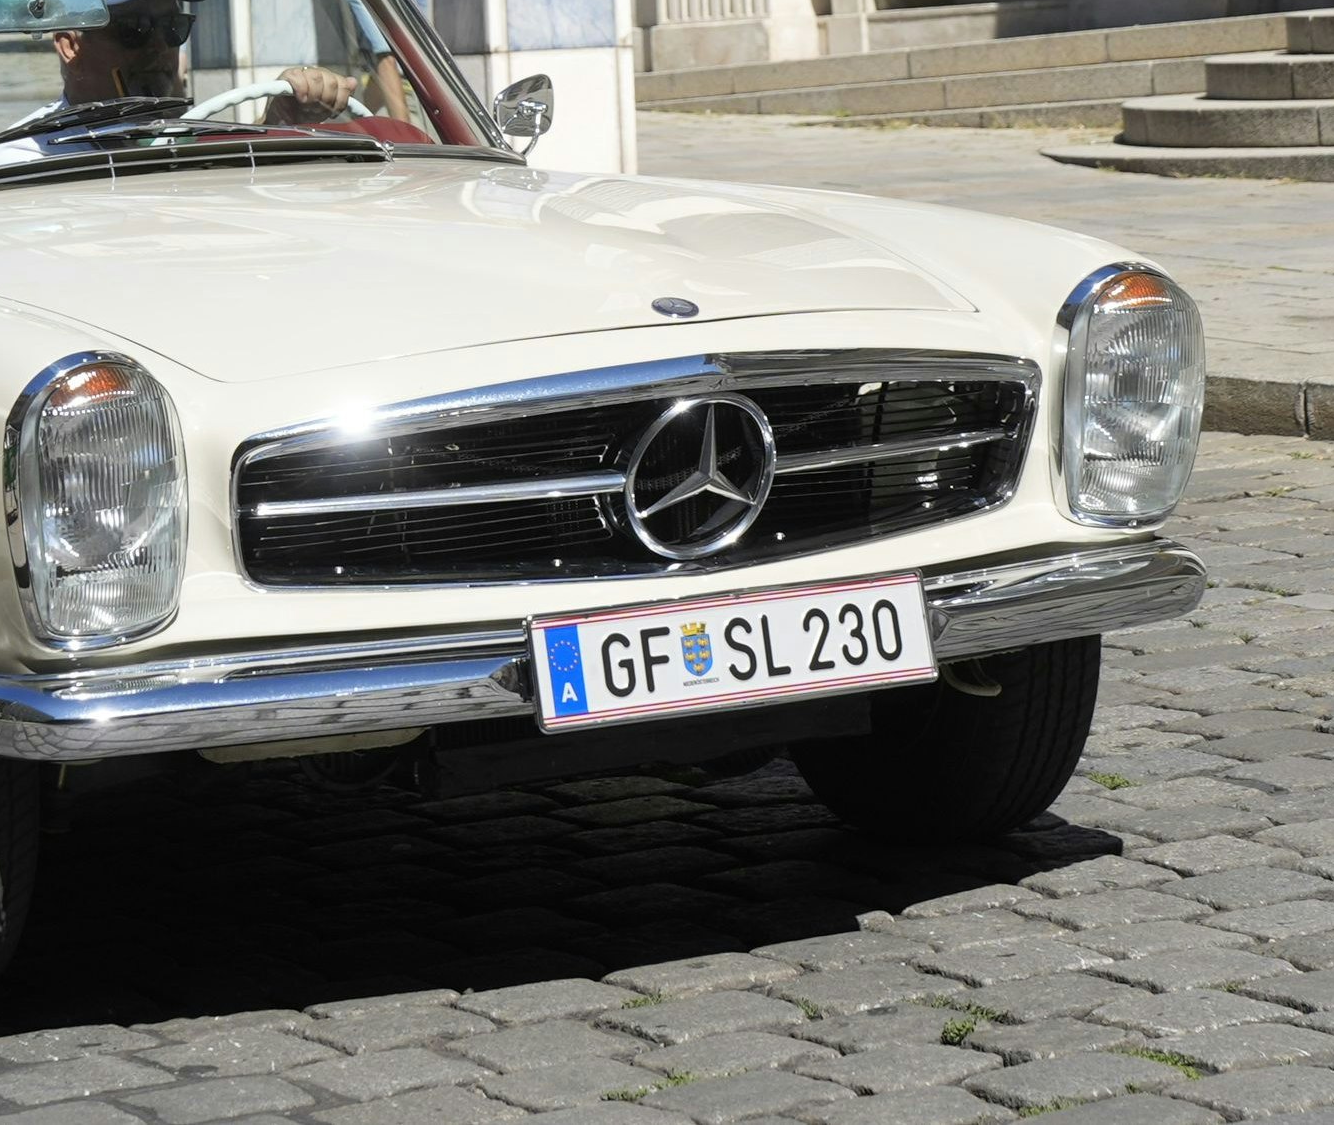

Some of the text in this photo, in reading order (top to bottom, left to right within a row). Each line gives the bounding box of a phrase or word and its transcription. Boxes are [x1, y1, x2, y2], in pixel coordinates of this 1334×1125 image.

[601, 599, 903, 698] GF SL 230
[561, 682, 579, 704] A
